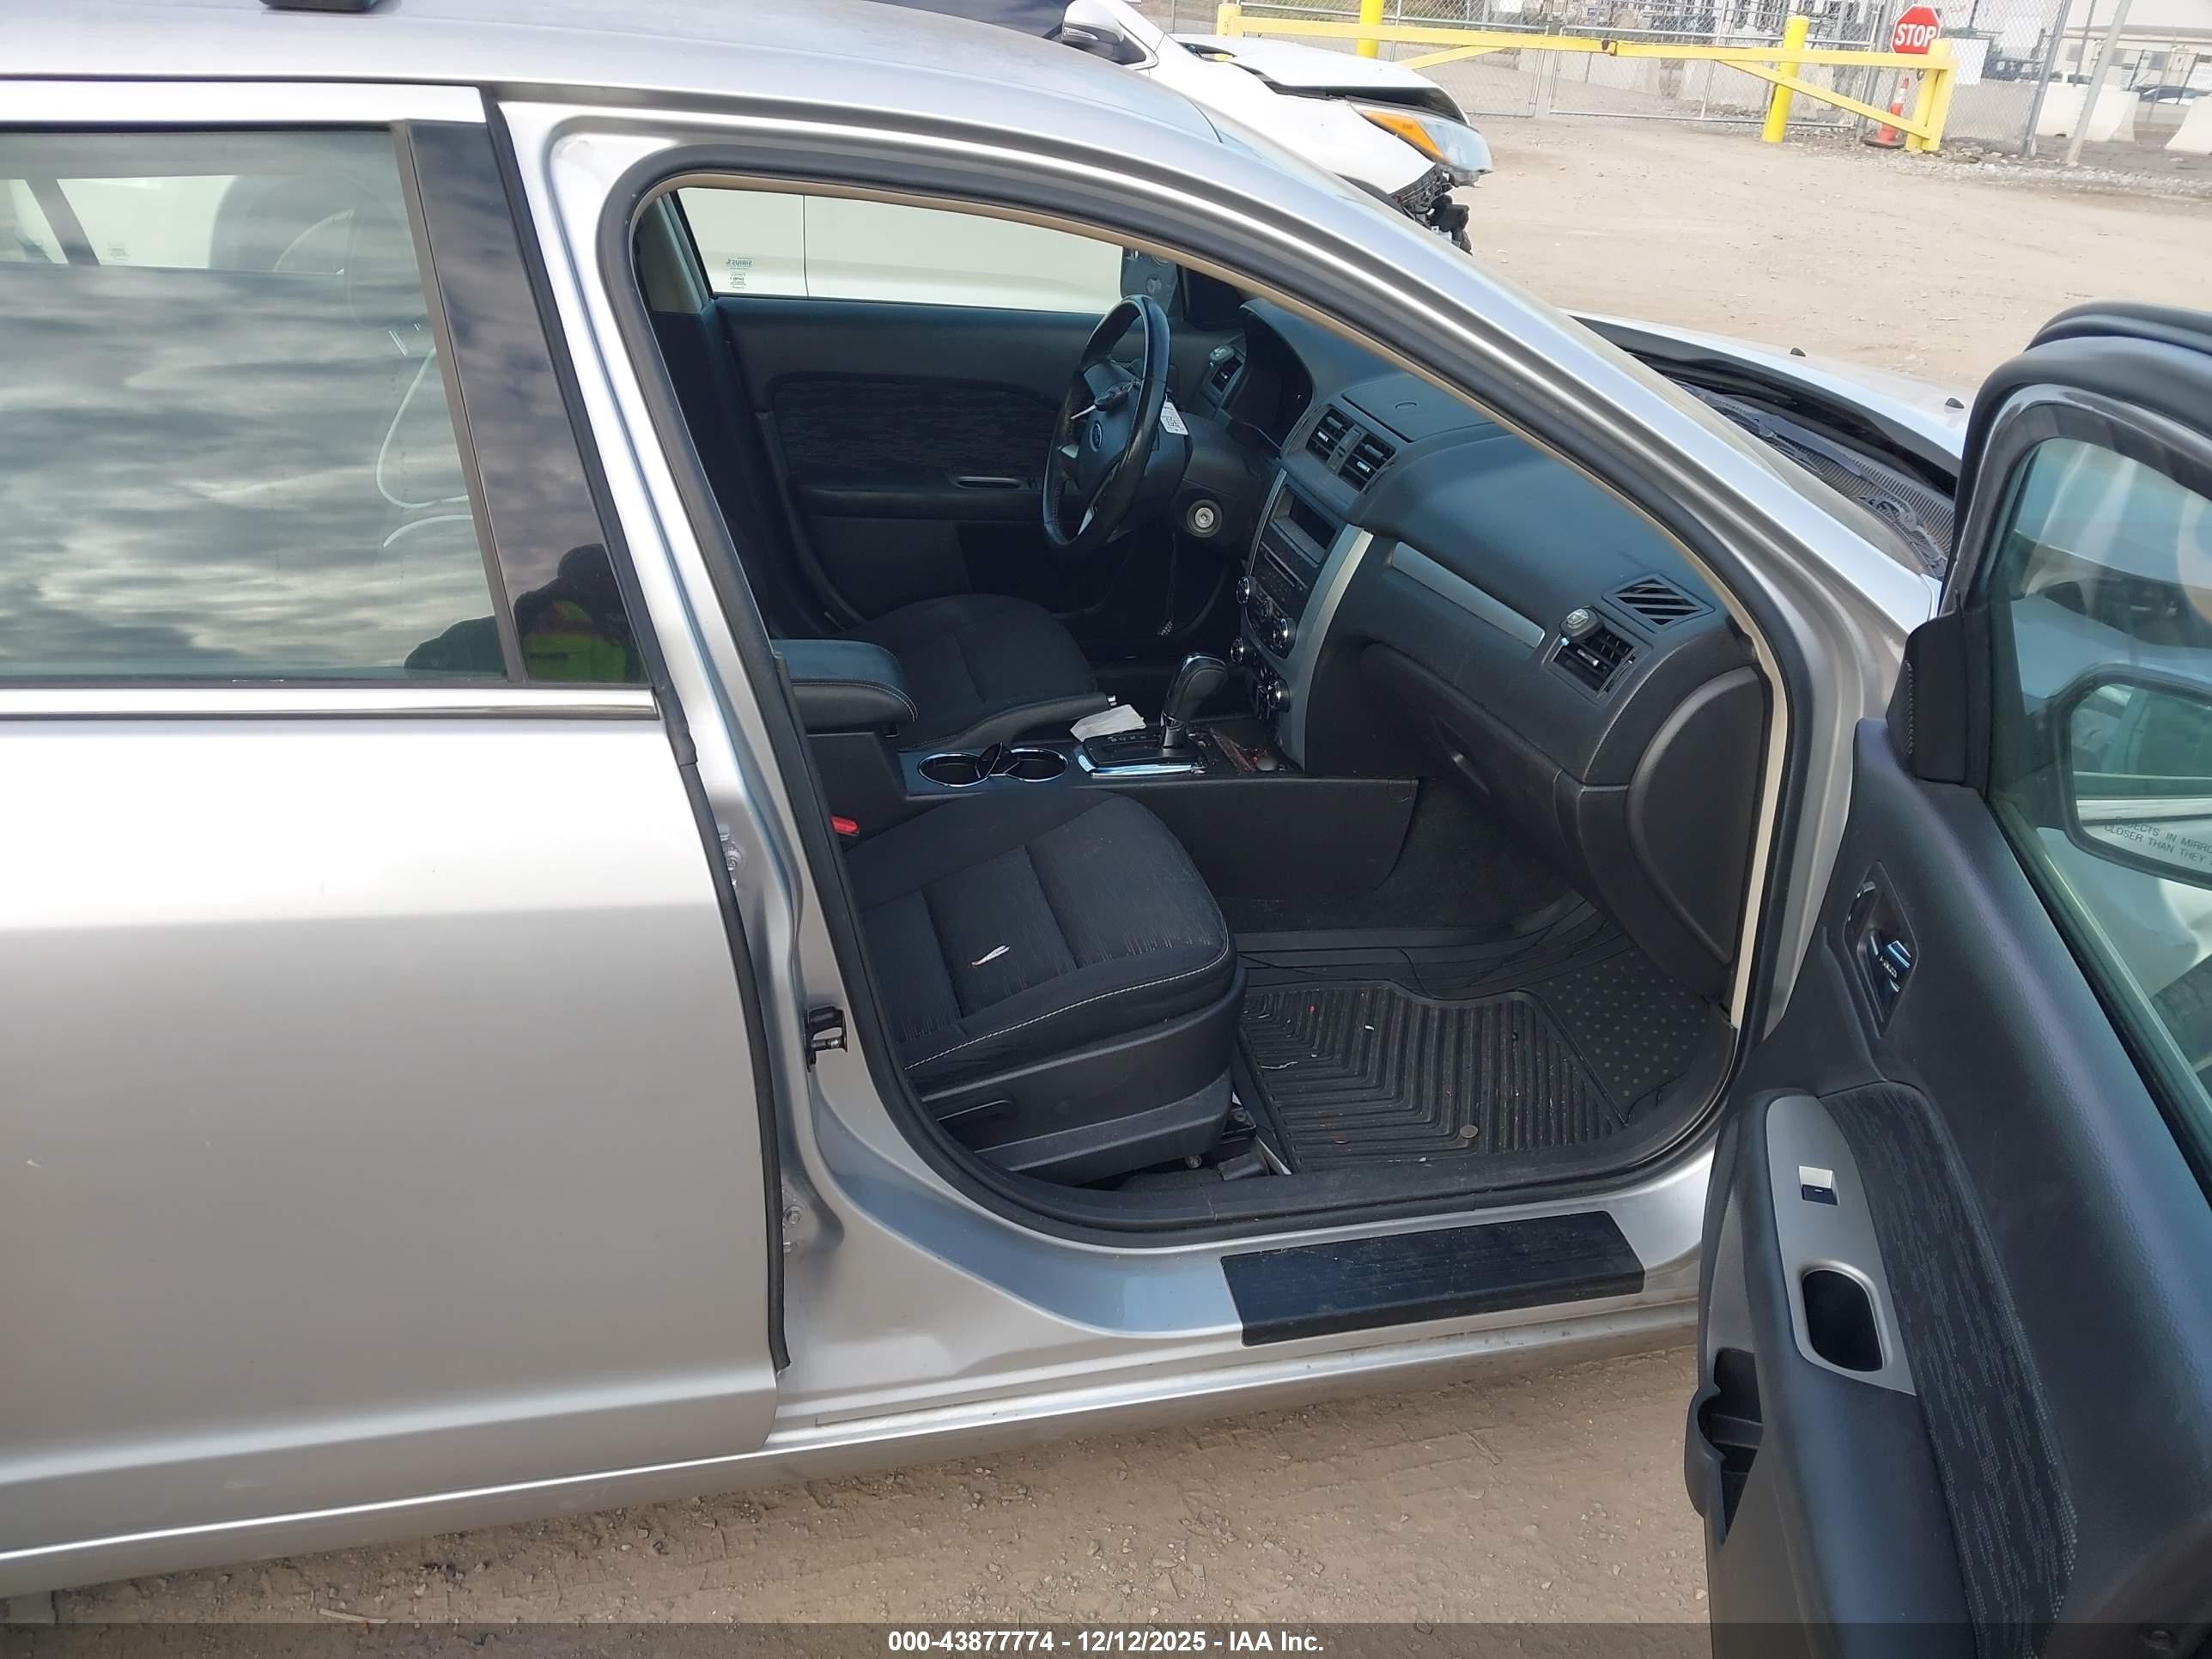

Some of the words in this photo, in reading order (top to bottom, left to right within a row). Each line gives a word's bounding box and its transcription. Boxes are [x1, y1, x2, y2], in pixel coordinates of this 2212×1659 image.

[1894, 23, 1937, 47] STOP
[2105, 823, 2143, 842] CLOSER
[2148, 837, 2175, 853] THAN
[2180, 848, 2206, 863] THEY
[2166, 832, 2178, 842] IN
